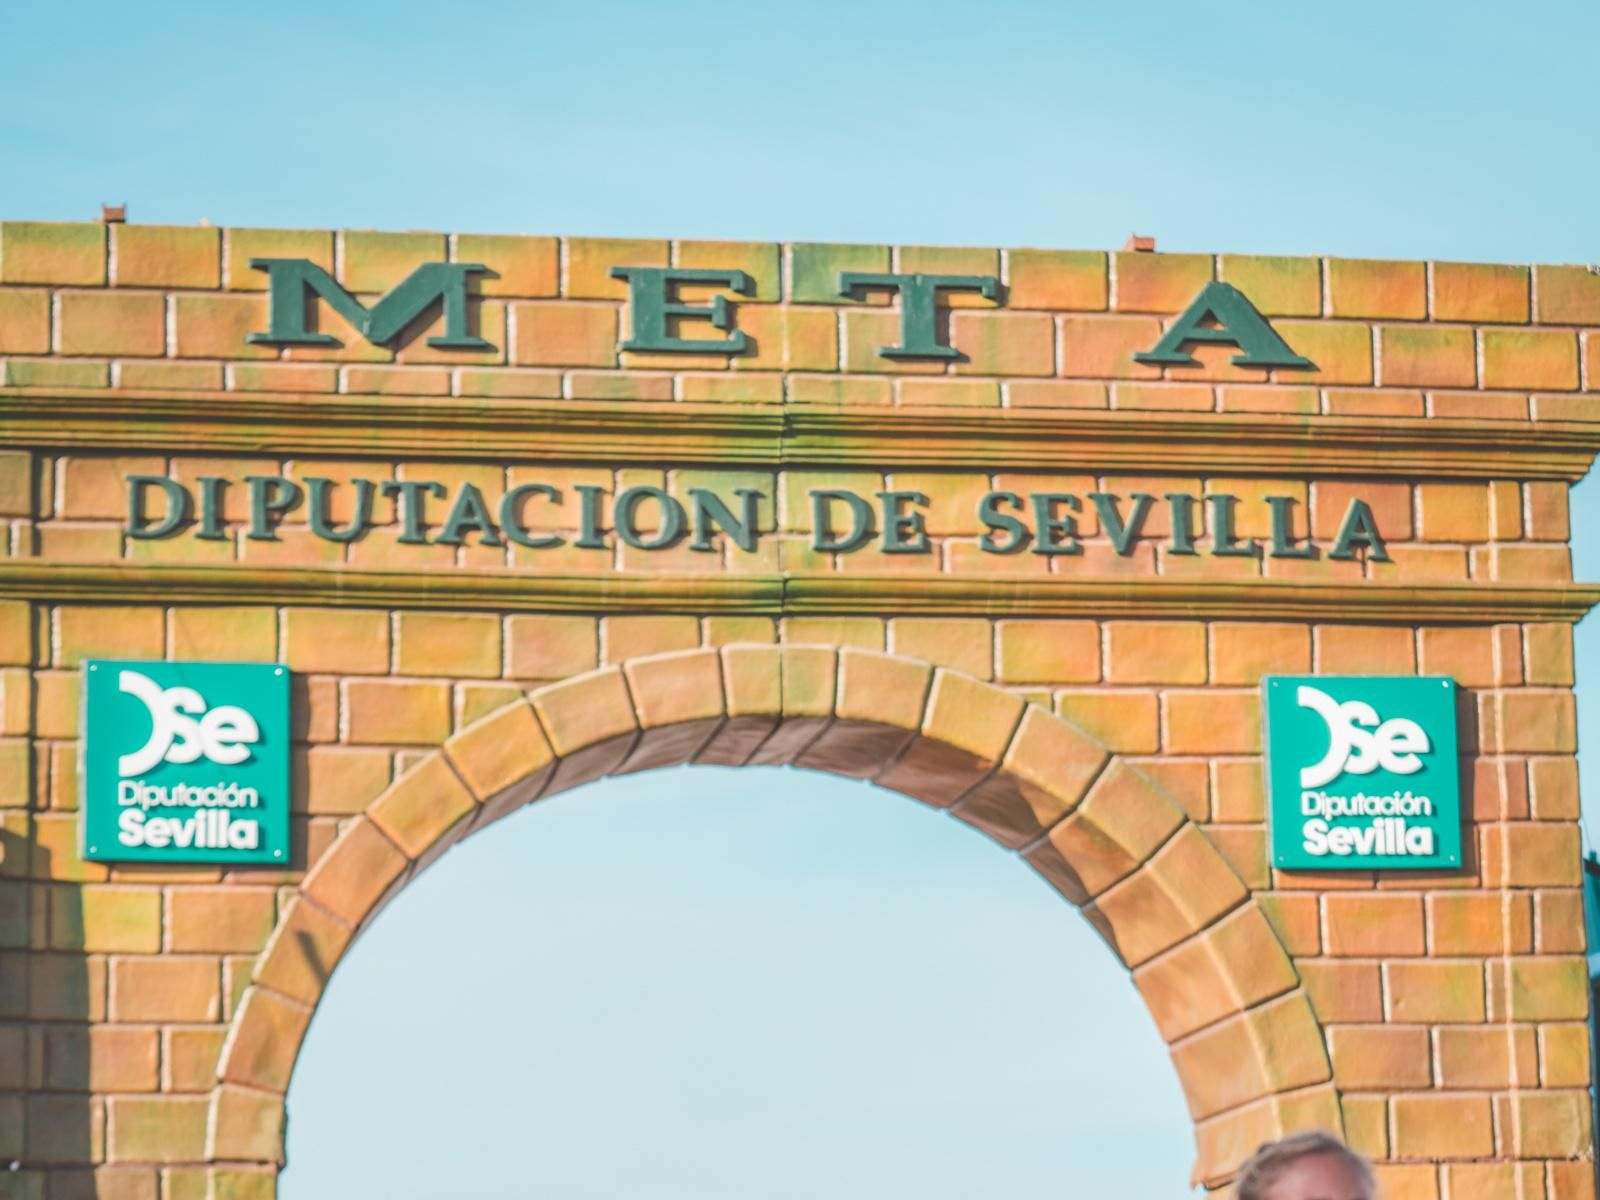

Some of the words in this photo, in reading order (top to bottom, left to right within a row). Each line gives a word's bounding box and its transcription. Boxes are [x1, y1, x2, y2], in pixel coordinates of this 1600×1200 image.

[247, 256, 1313, 370] META
[125, 474, 763, 553] DIPUTACION
[809, 489, 930, 555] DE
[978, 492, 1389, 562] SEVILLA
[118, 779, 258, 809] Diputación
[1302, 791, 1431, 817] Diputación
[118, 809, 258, 850] Sevilla
[1302, 818, 1434, 856] Sevilla
